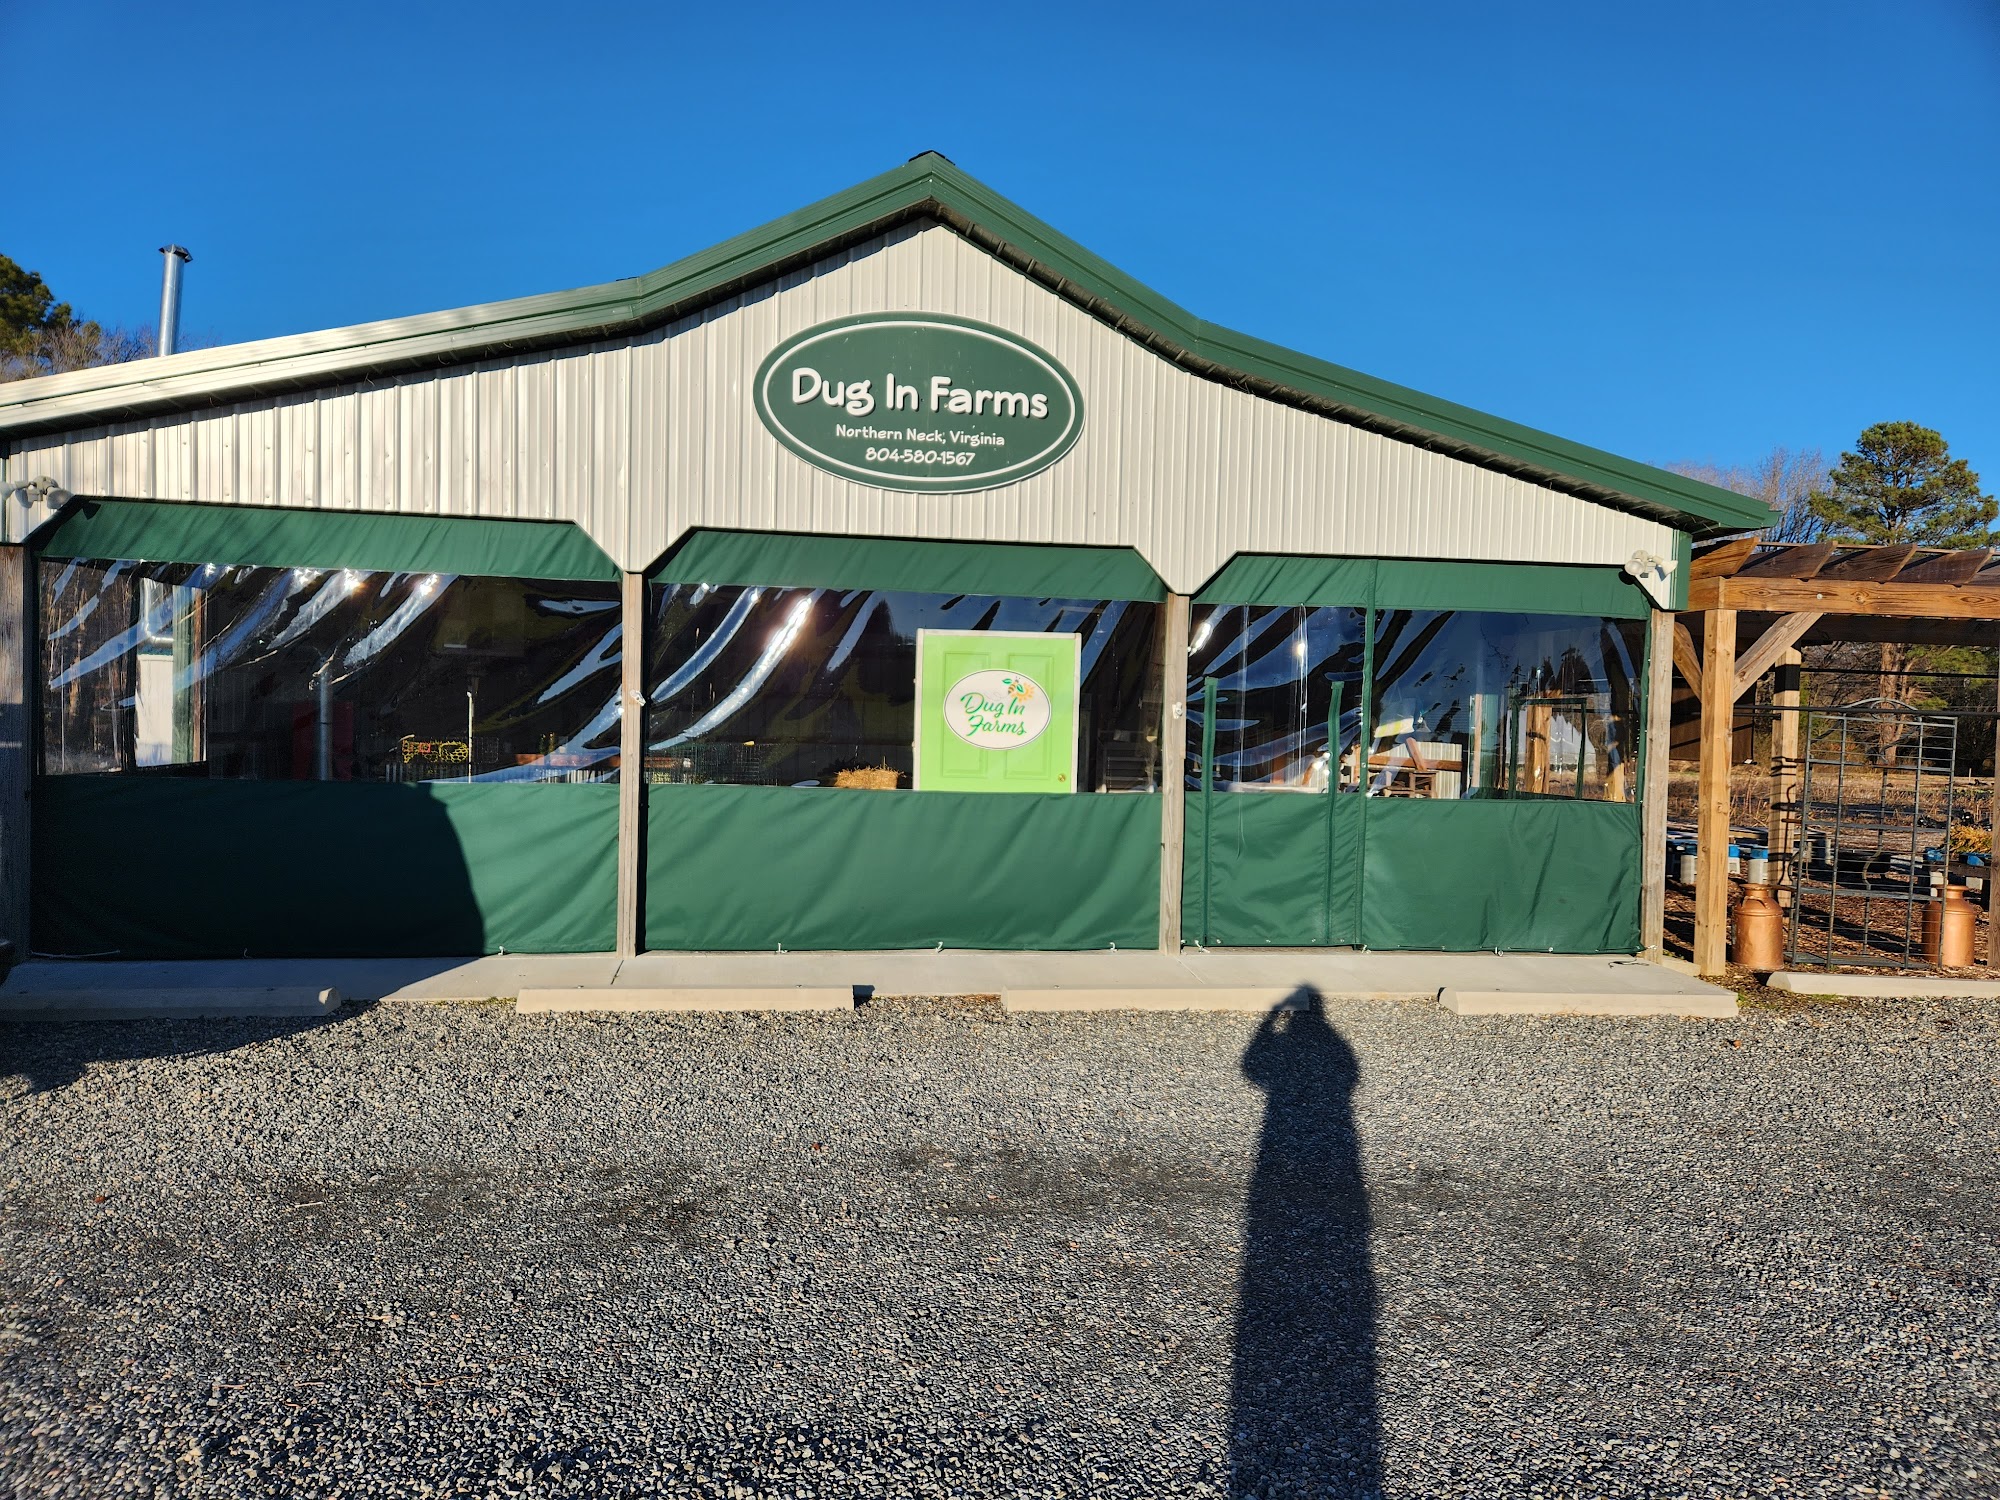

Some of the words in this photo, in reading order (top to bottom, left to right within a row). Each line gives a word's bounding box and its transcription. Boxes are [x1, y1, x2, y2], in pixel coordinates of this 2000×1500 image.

[792, 367, 874, 416] Dug
[886, 373, 918, 410] In
[930, 376, 1048, 418] Farms
[836, 424, 902, 440] Northern
[950, 430, 1005, 446] Virginia
[865, 447, 975, 466] 804-580-1567
[960, 692, 1004, 717] Dug
[1008, 697, 1025, 715] In
[966, 715, 1027, 736] Farms
